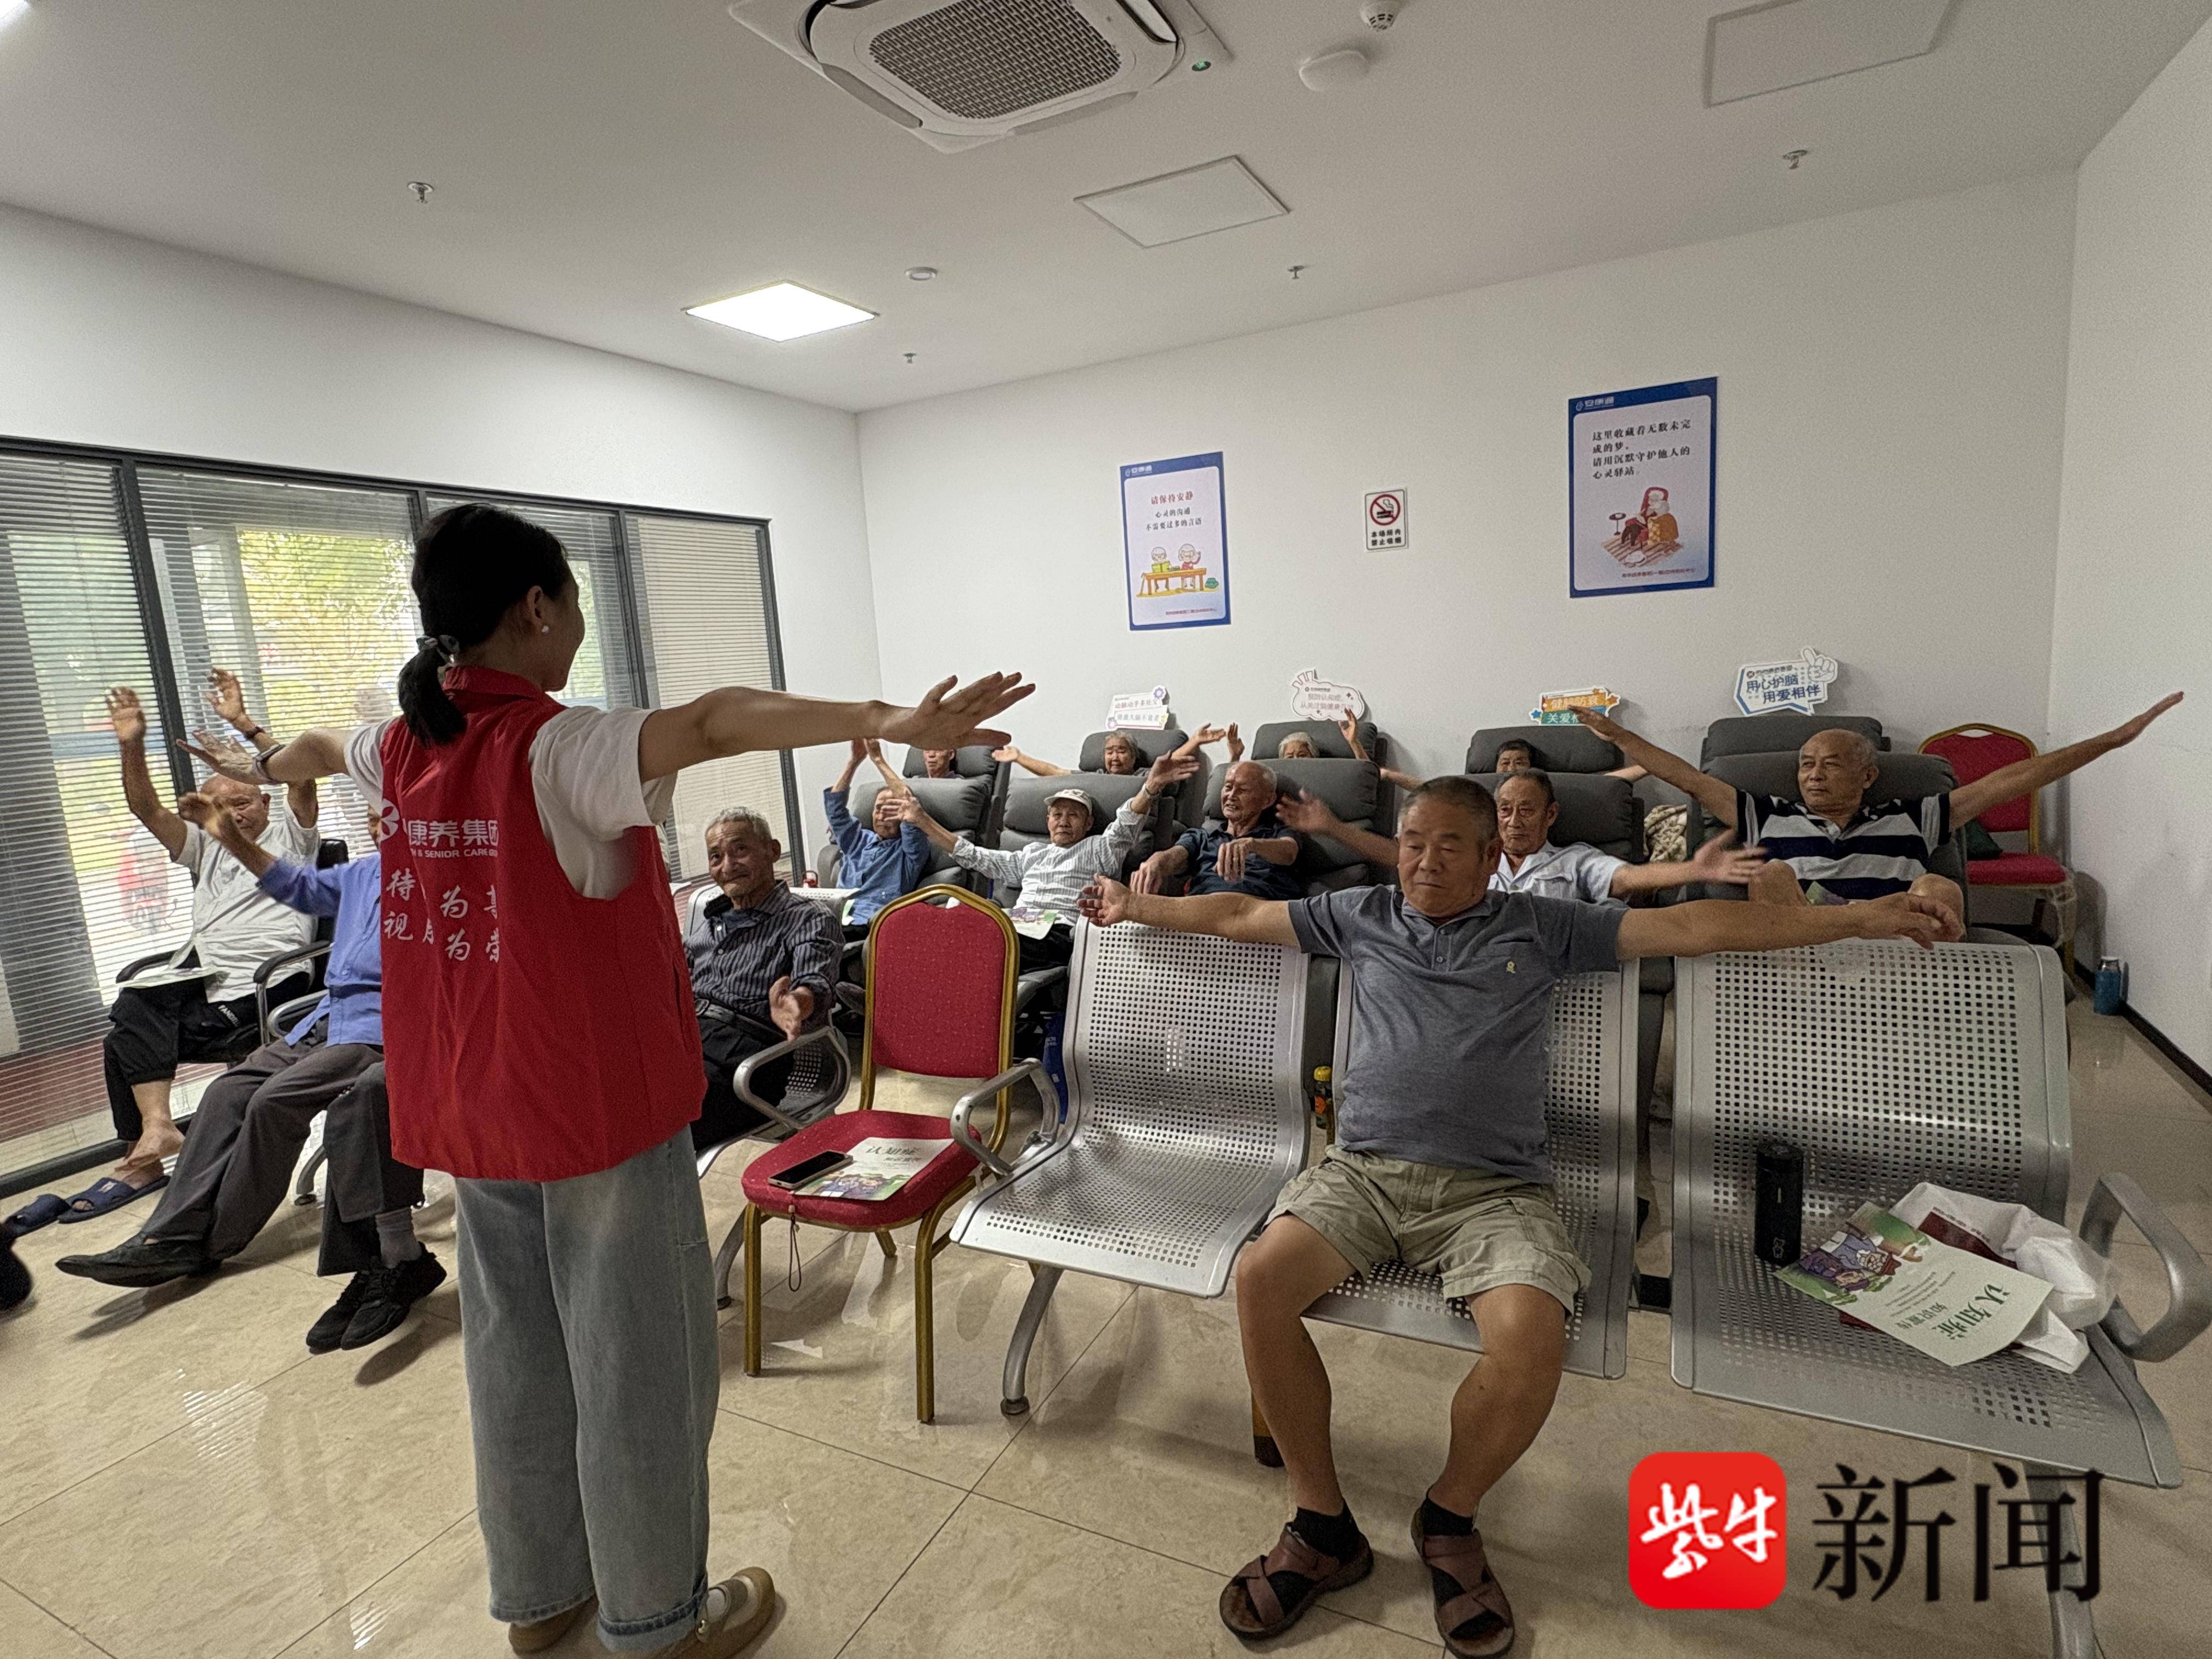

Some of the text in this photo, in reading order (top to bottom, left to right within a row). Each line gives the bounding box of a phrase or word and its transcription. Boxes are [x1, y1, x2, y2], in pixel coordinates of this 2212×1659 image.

[1593, 419, 1691, 441] 这里收藏着无数未完
[1593, 446, 1690, 467] 请用沉默守护他人的
[1151, 490, 1193, 505] 请保持安静
[1155, 506, 1190, 518] 心灵的沟通
[1746, 674, 1799, 693] 用心护脑
[1763, 684, 1822, 704] 用爱相伴
[403, 818, 499, 847] 康养集团
[425, 850, 460, 859] SENIOR
[464, 848, 488, 857] CARE
[1932, 1283, 2010, 1341] 认知症
